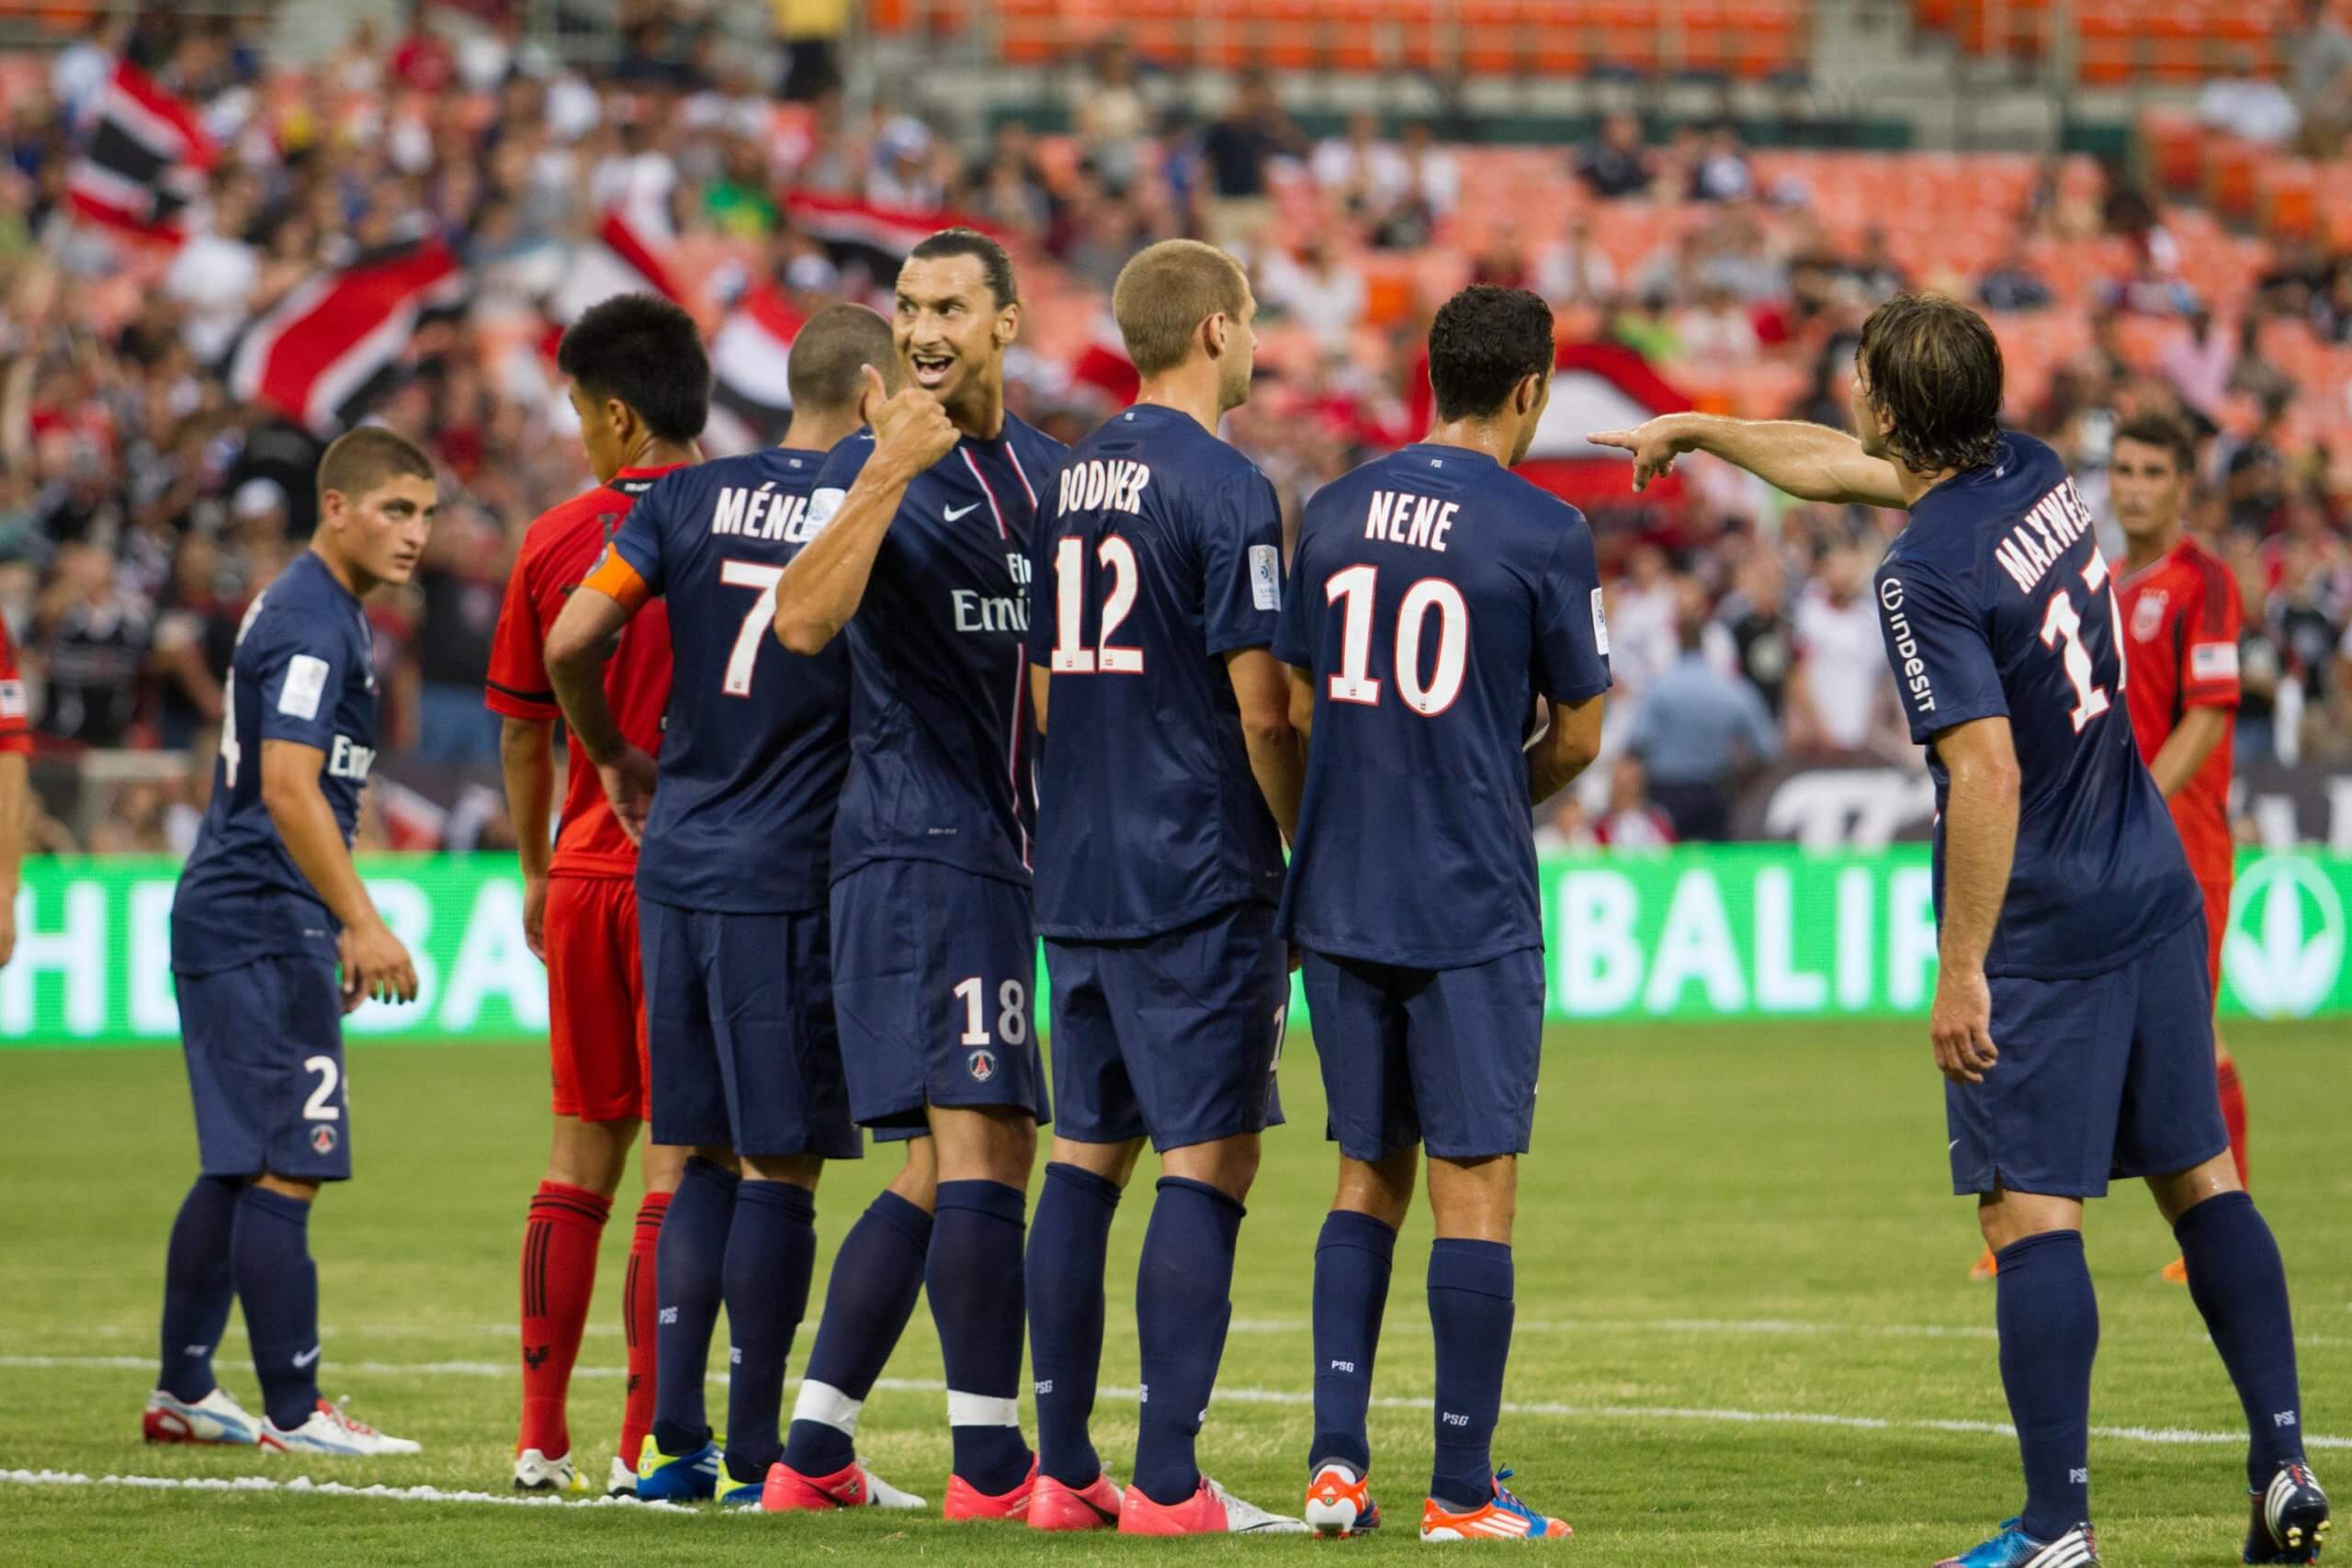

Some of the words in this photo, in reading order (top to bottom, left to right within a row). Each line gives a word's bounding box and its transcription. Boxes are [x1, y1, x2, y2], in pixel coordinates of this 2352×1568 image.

[1364, 491, 1460, 552] NENE
[720, 558, 786, 698] 7
[951, 588, 1031, 632] Emi
[1051, 533, 1145, 674] 12
[1324, 563, 1470, 718] 10
[953, 976, 1026, 1045] 18
[1331, 1359, 1354, 1372] PSG
[1442, 1411, 1469, 1426] PSG
[2273, 1410, 2295, 1427] PSG
